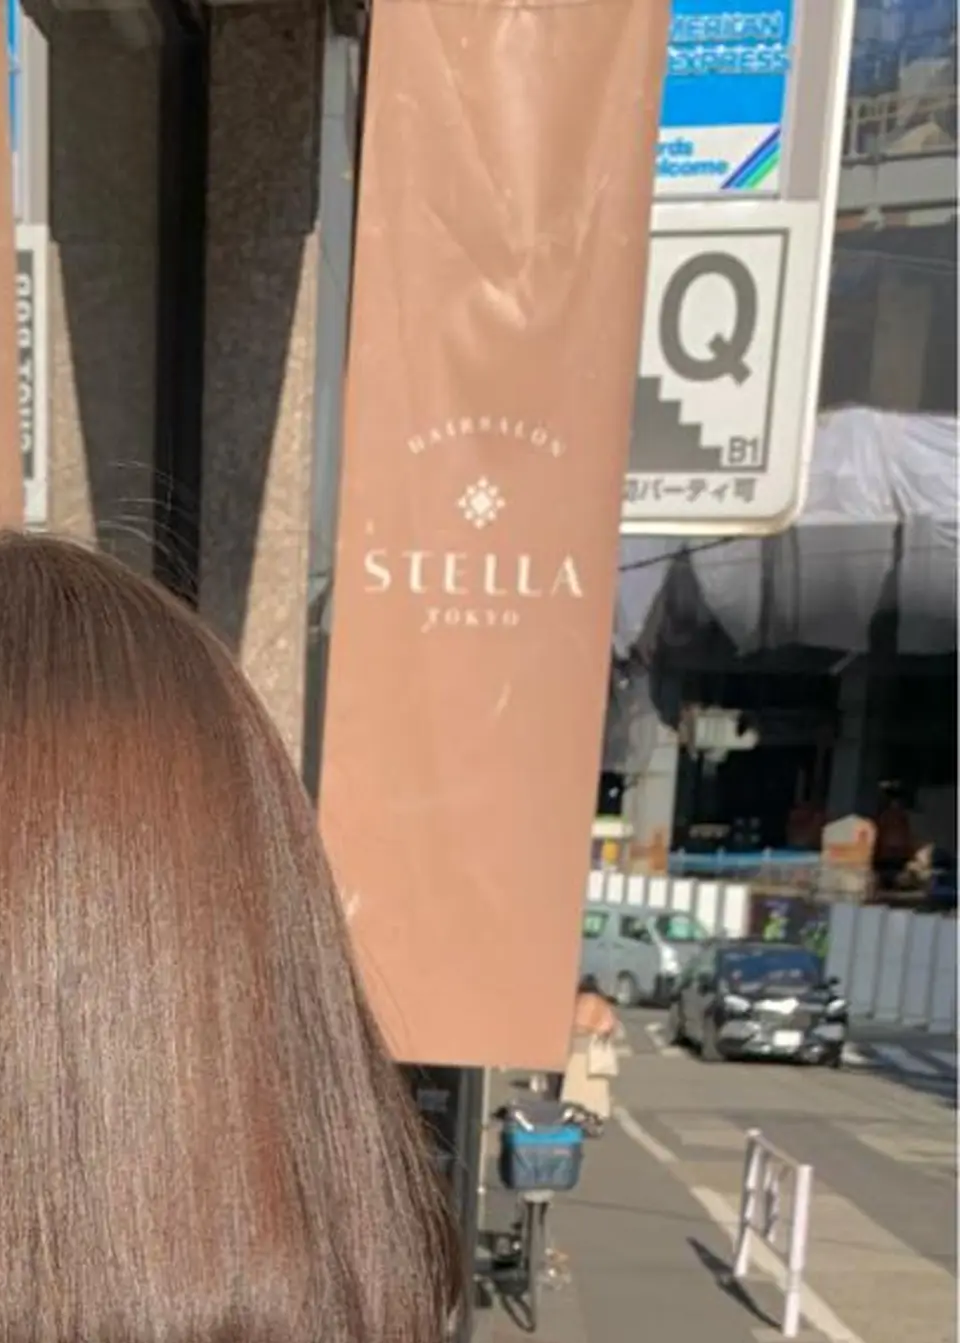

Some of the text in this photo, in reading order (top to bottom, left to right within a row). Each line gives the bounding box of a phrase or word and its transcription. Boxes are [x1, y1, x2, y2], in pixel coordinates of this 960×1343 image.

[658, 251, 759, 388] Q
[728, 436, 759, 465] B1
[363, 549, 583, 598] STELLA
[426, 606, 521, 628] TOKYO
